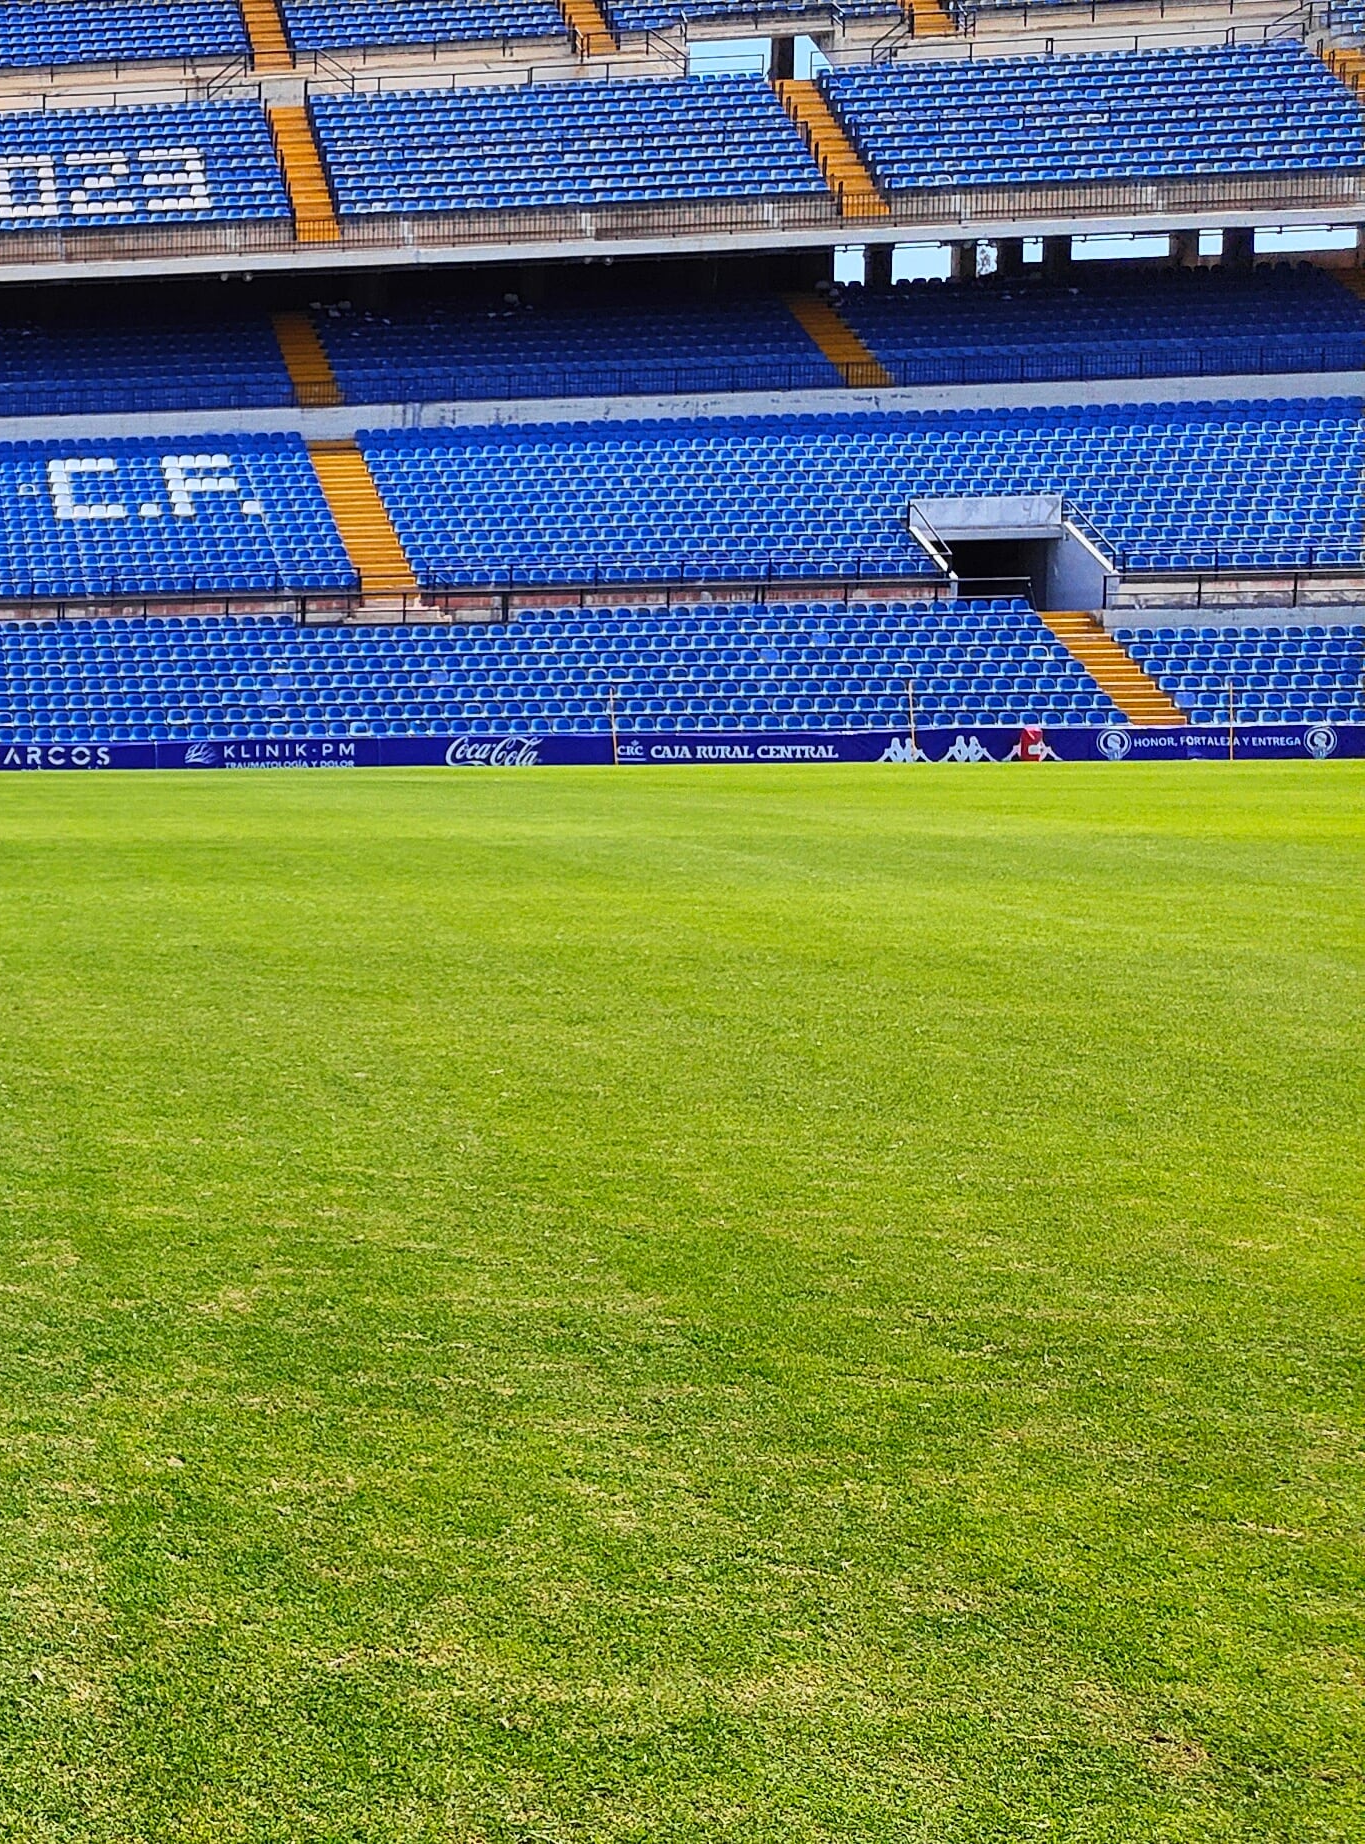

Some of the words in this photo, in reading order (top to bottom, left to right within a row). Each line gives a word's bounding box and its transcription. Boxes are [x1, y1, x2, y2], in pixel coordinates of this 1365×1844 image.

[1180, 735, 1241, 746] FORTALEZA
[1242, 736, 1249, 746] Y
[1251, 736, 1301, 746] ENTREGA
[617, 745, 643, 756] CRC
[651, 745, 693, 759] CAJA
[696, 745, 754, 758] RURAL
[756, 745, 839, 758] CENTRAL
[311, 760, 318, 768] Y
[320, 760, 355, 768] DOLOR
